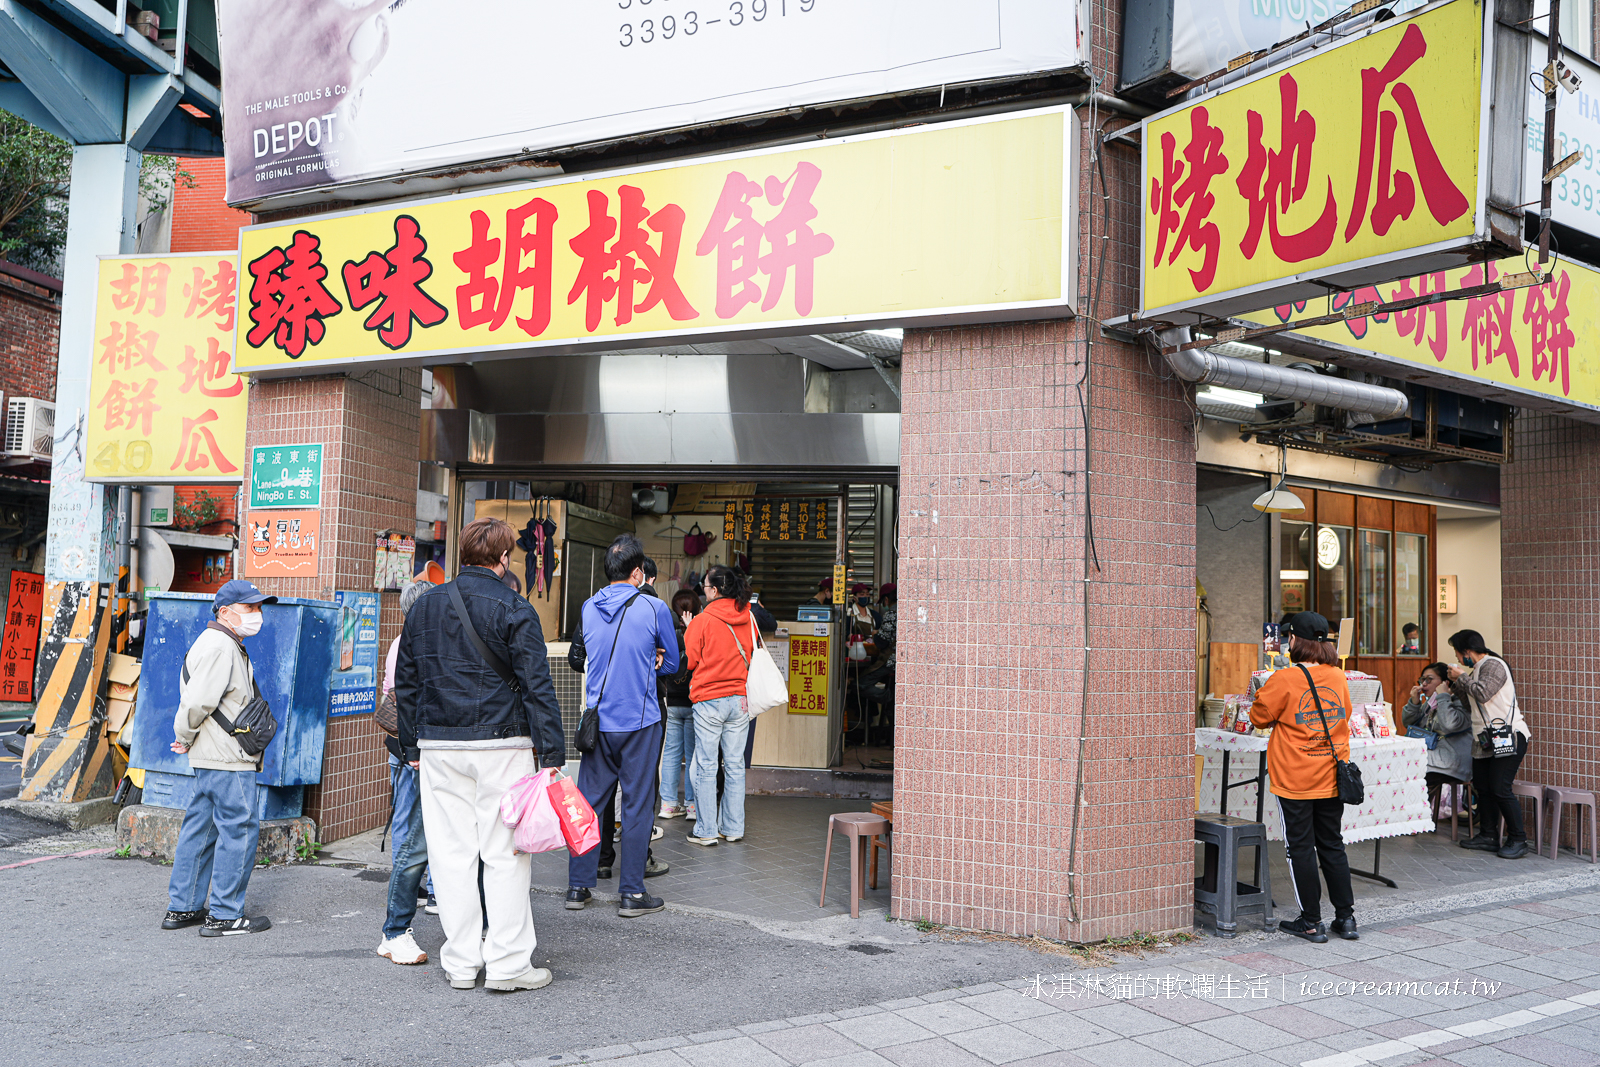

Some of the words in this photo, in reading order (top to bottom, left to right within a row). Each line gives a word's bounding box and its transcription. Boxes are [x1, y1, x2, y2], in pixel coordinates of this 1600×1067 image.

[245, 102, 262, 116] THE
[265, 95, 290, 111] MALE
[292, 88, 322, 104] TOOLS
[324, 86, 332, 98] &
[334, 84, 350, 96] Co.
[253, 112, 337, 159] DEPOT
[255, 166, 294, 182] ORIGINAL
[296, 158, 340, 175] FORMULAS
[1151, 23, 1470, 293] 烤地瓜
[246, 160, 835, 359] 臻味胡椒餅
[1274, 261, 1576, 397] 胡椒餅
[97, 261, 172, 437] 胡椒餅
[169, 259, 244, 475] 烤地瓜
[256, 449, 318, 465] 寧波東街
[257, 490, 285, 503] NingBo
[288, 489, 296, 500] E.
[300, 489, 312, 500] St.
[2, 577, 28, 696] 行人請小心慢行
[18, 579, 43, 696] 前有工區
[791, 639, 828, 658] 營業時間
[791, 659, 827, 676] 早上11點
[803, 676, 813, 693] 至
[789, 694, 826, 711] 晚上8點
